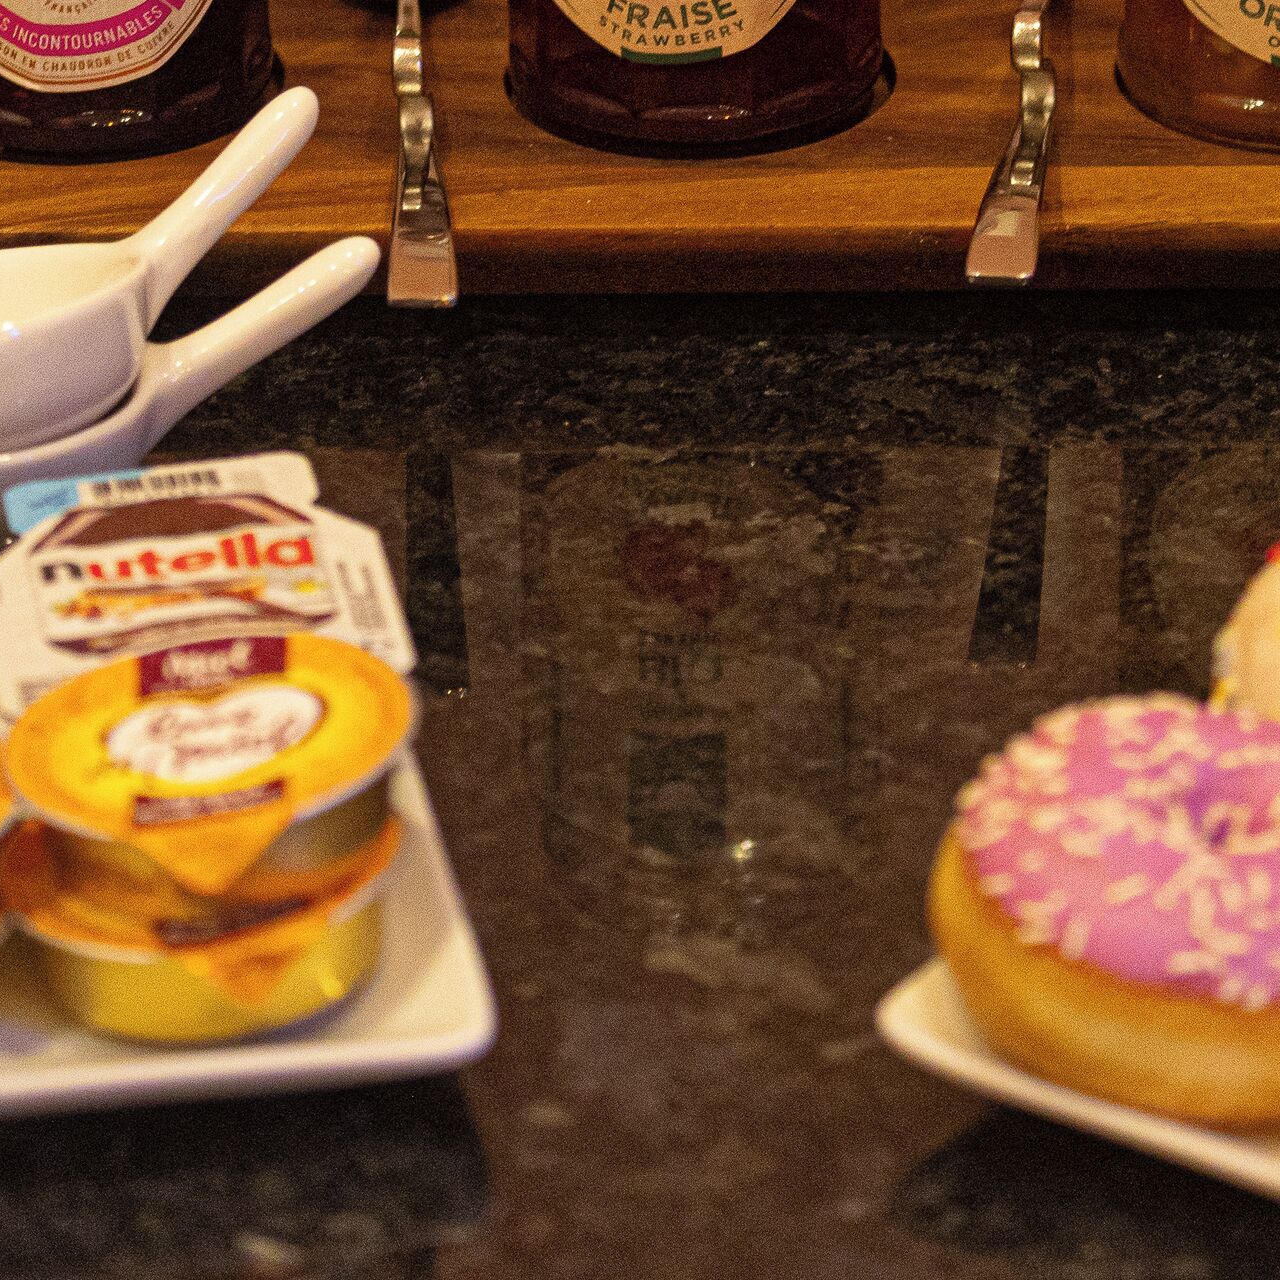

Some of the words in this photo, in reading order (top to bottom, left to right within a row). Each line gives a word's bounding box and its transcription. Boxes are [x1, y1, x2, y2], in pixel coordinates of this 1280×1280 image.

[12, 4, 164, 50] INCONTOURNABLES
[21, 56, 37, 70] EN
[41, 51, 112, 72] CHAUDRON
[117, 48, 132, 63] DE
[136, 21, 176, 56] CUIVRE
[599, 14, 745, 47] STRAWBERRY
[39, 531, 317, 583] nutella
